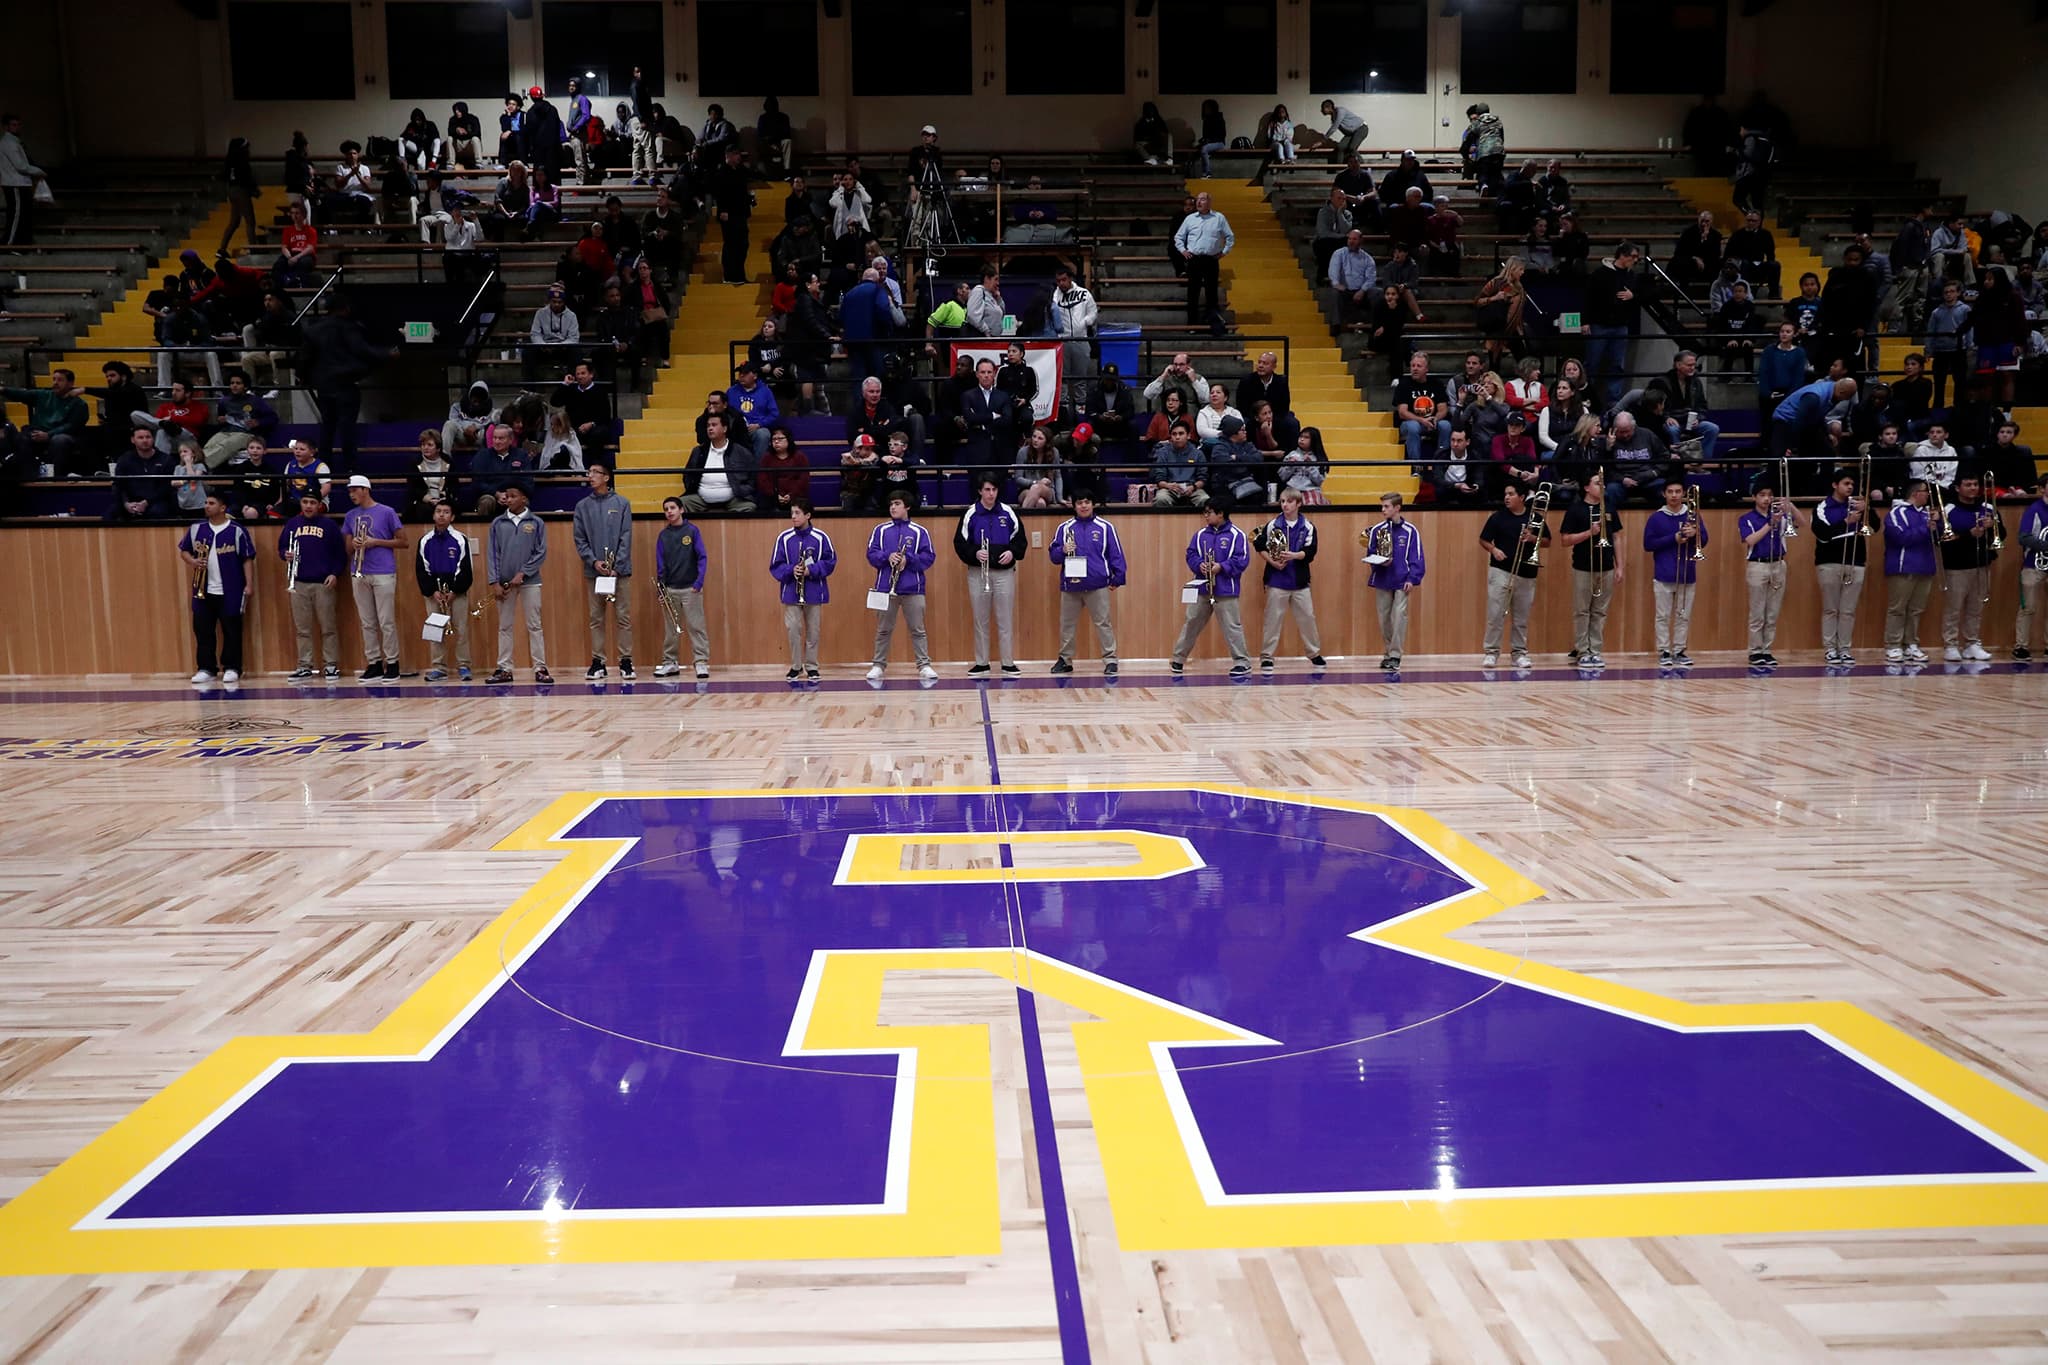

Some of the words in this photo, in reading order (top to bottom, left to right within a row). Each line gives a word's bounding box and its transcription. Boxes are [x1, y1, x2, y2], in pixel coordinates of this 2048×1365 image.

[1062, 290, 1088, 303] NIKE
[409, 323, 429, 337] EXIT
[294, 525, 325, 539] ARHS
[35, 735, 324, 748] COURT
[0, 749, 171, 760] RES
[176, 740, 428, 758] KEVIN
